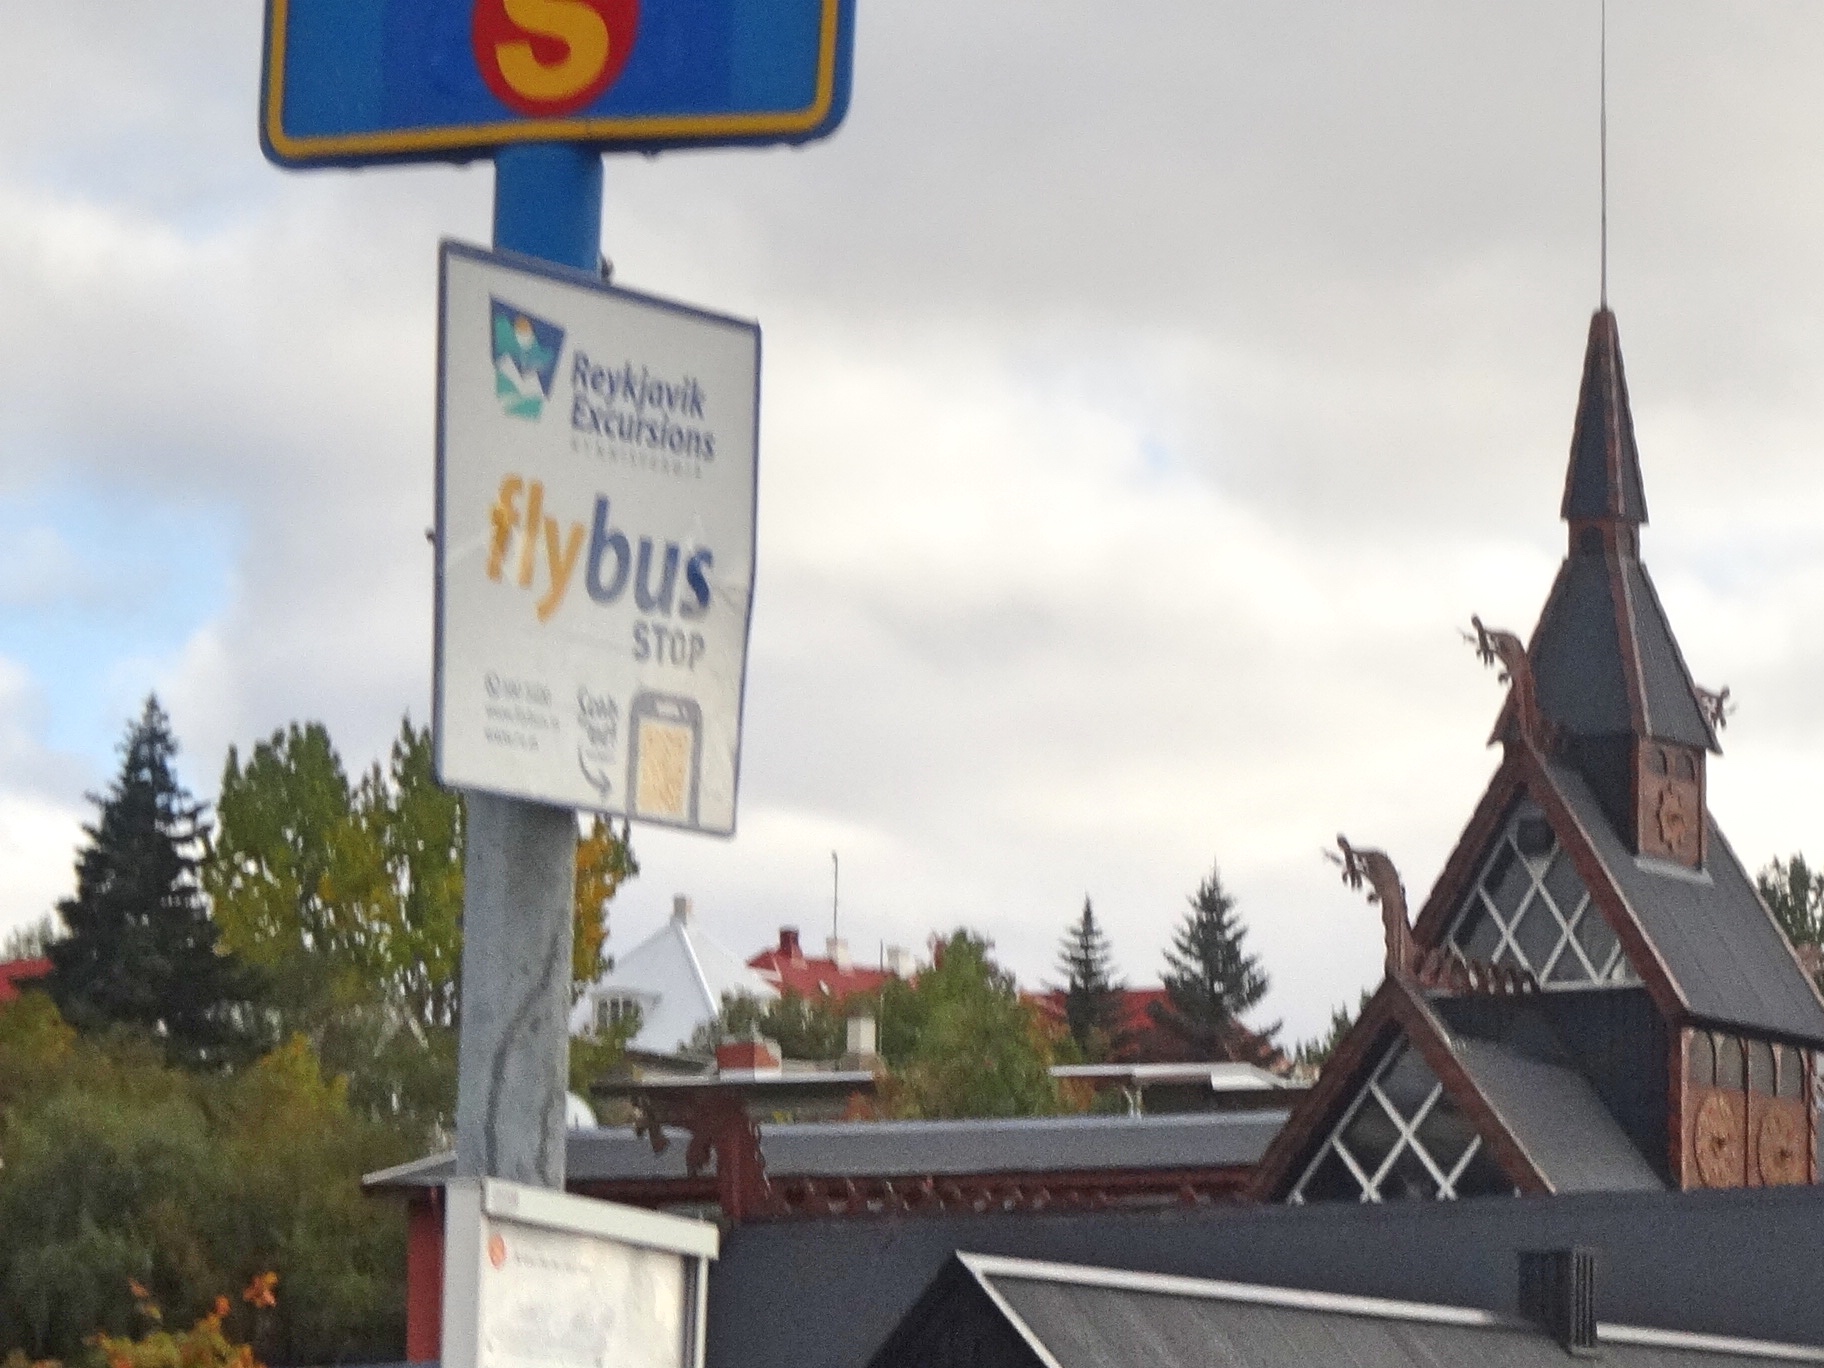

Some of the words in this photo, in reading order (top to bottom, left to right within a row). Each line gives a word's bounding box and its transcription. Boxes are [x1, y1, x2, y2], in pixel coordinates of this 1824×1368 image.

[572, 350, 704, 419] Reykjavik
[571, 395, 715, 461] Excursions
[486, 473, 714, 622] flybus
[632, 619, 705, 670] STOP
